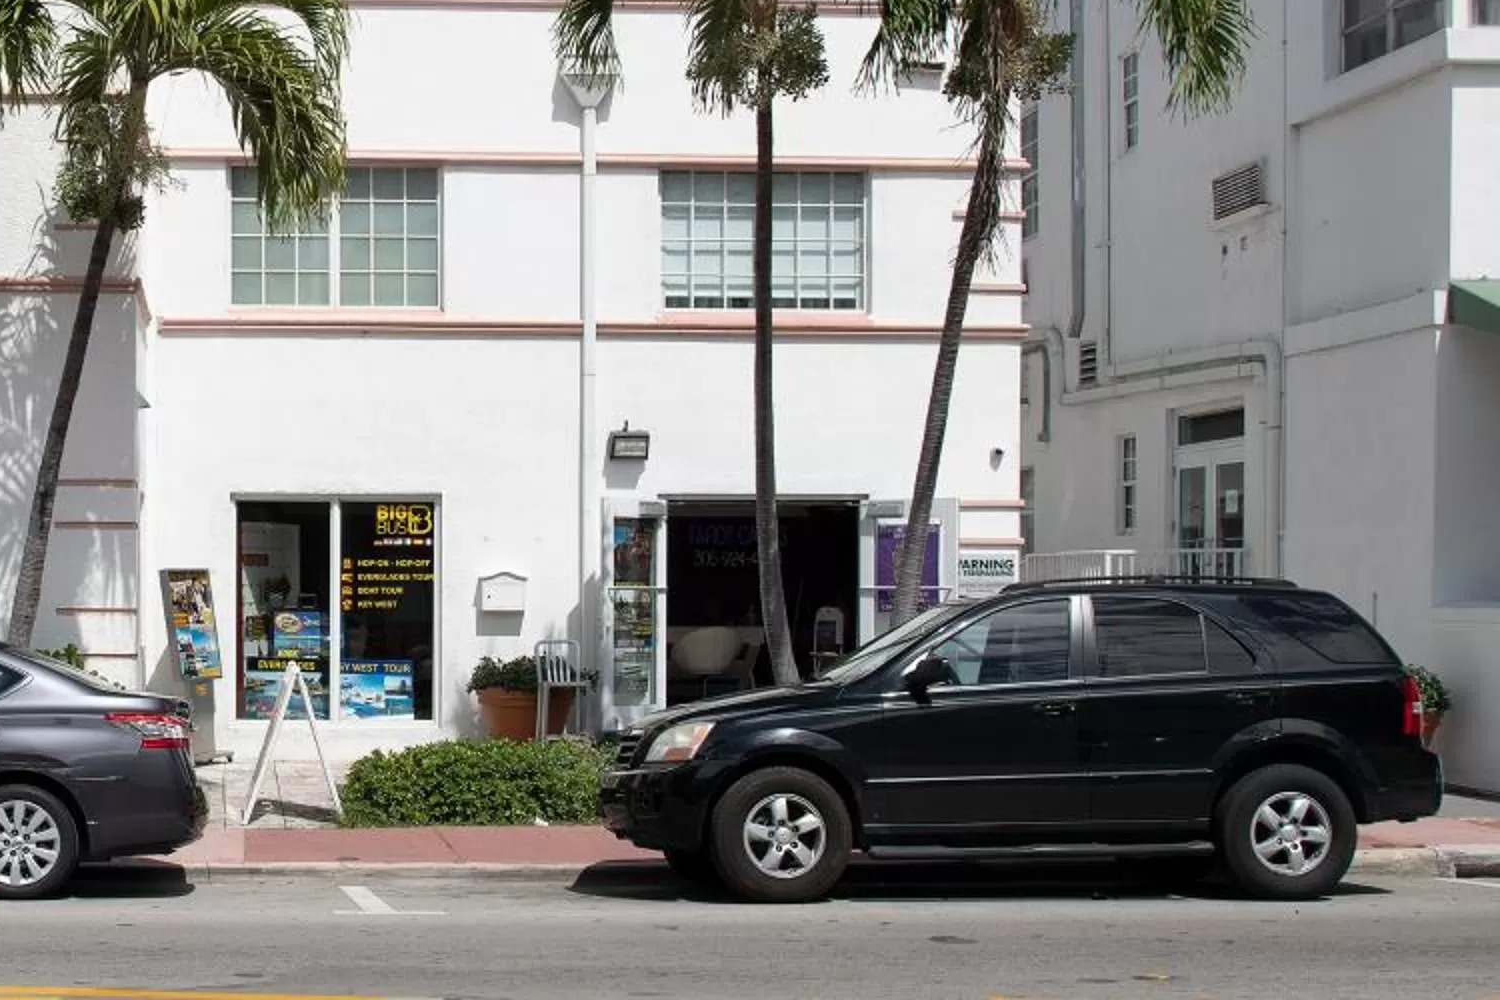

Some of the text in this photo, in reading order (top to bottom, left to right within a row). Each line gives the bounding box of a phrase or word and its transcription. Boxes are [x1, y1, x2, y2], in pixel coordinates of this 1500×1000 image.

[376, 505, 407, 520] BIG
[376, 521, 406, 535] BUS
[351, 663, 379, 673] WEST
[384, 663, 411, 673] TOUR
